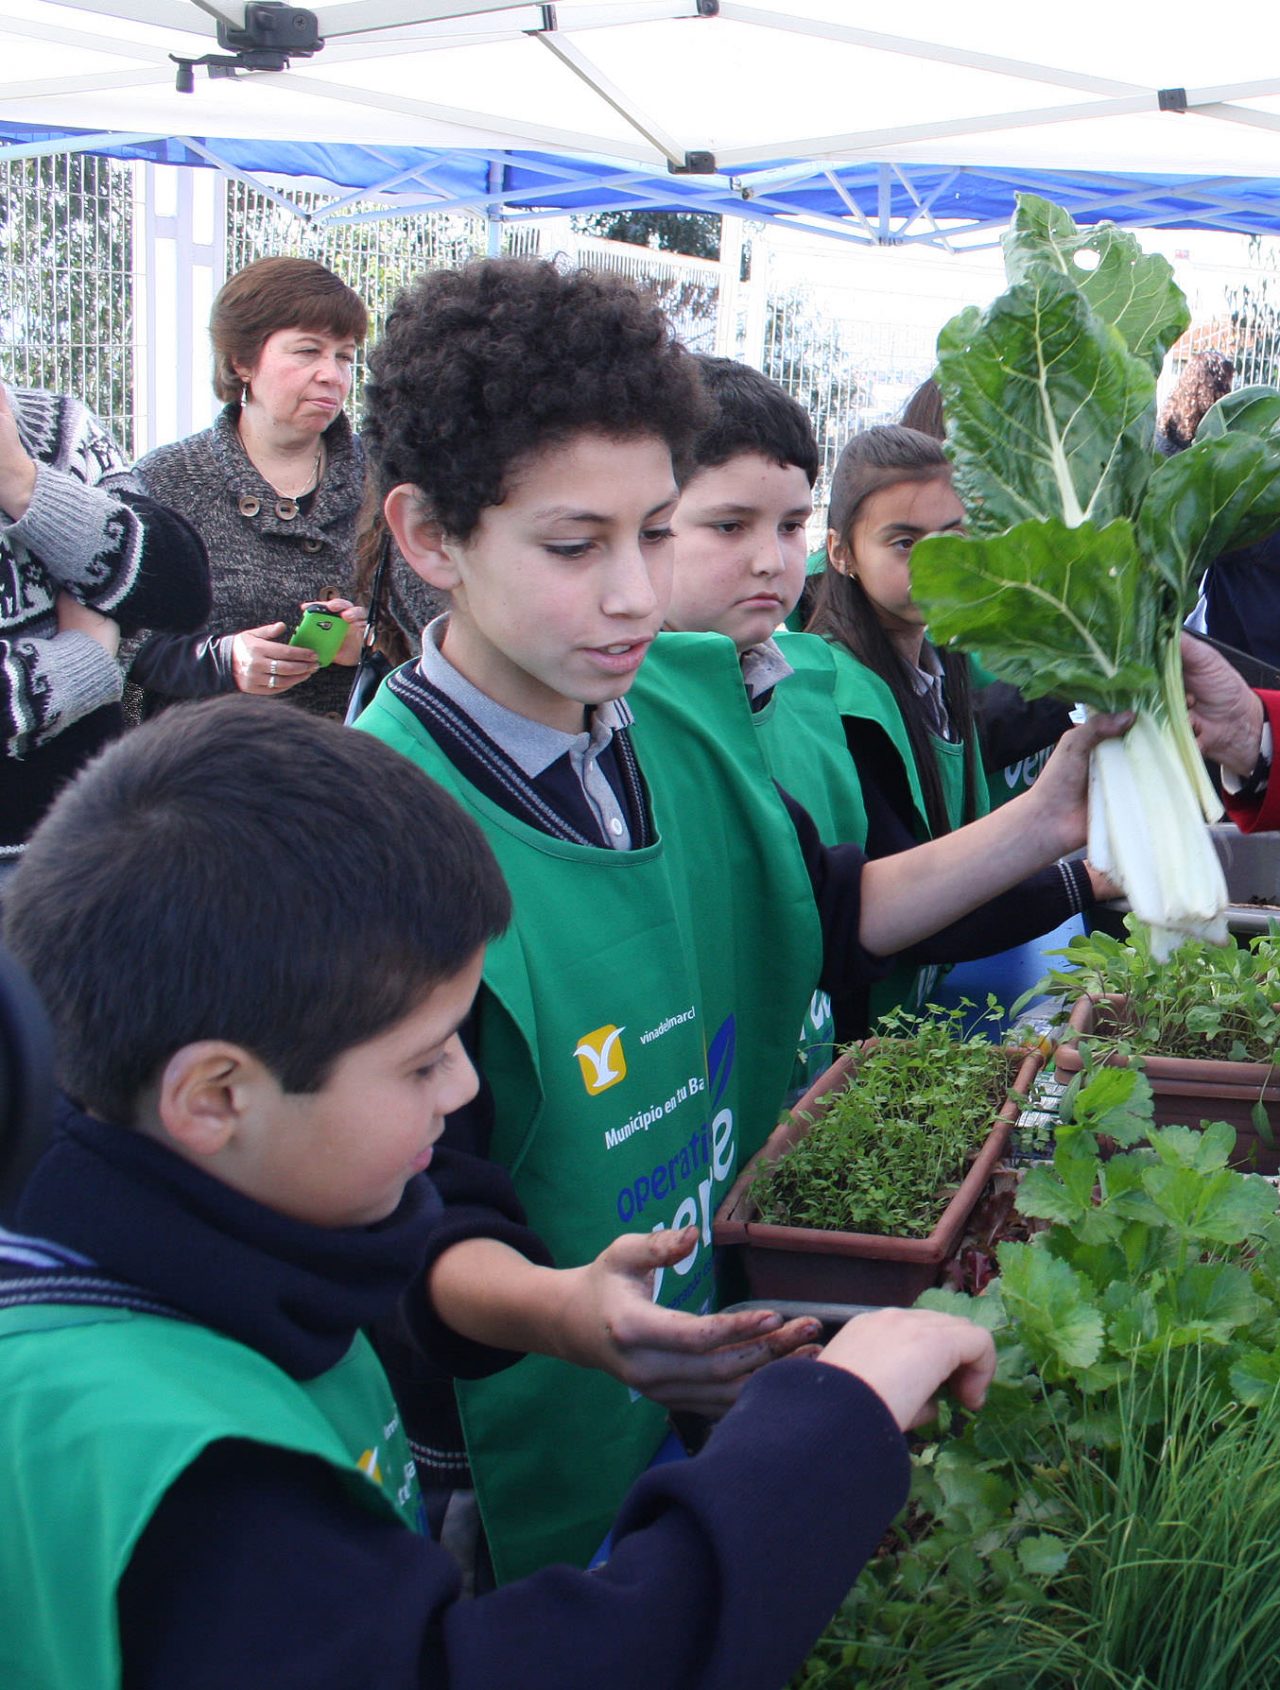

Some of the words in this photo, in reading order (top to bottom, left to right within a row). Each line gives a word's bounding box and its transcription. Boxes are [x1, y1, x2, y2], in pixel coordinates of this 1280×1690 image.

[604, 1105, 663, 1150] Municipio
[664, 1096, 677, 1114] en
[676, 1086, 688, 1103] tu
